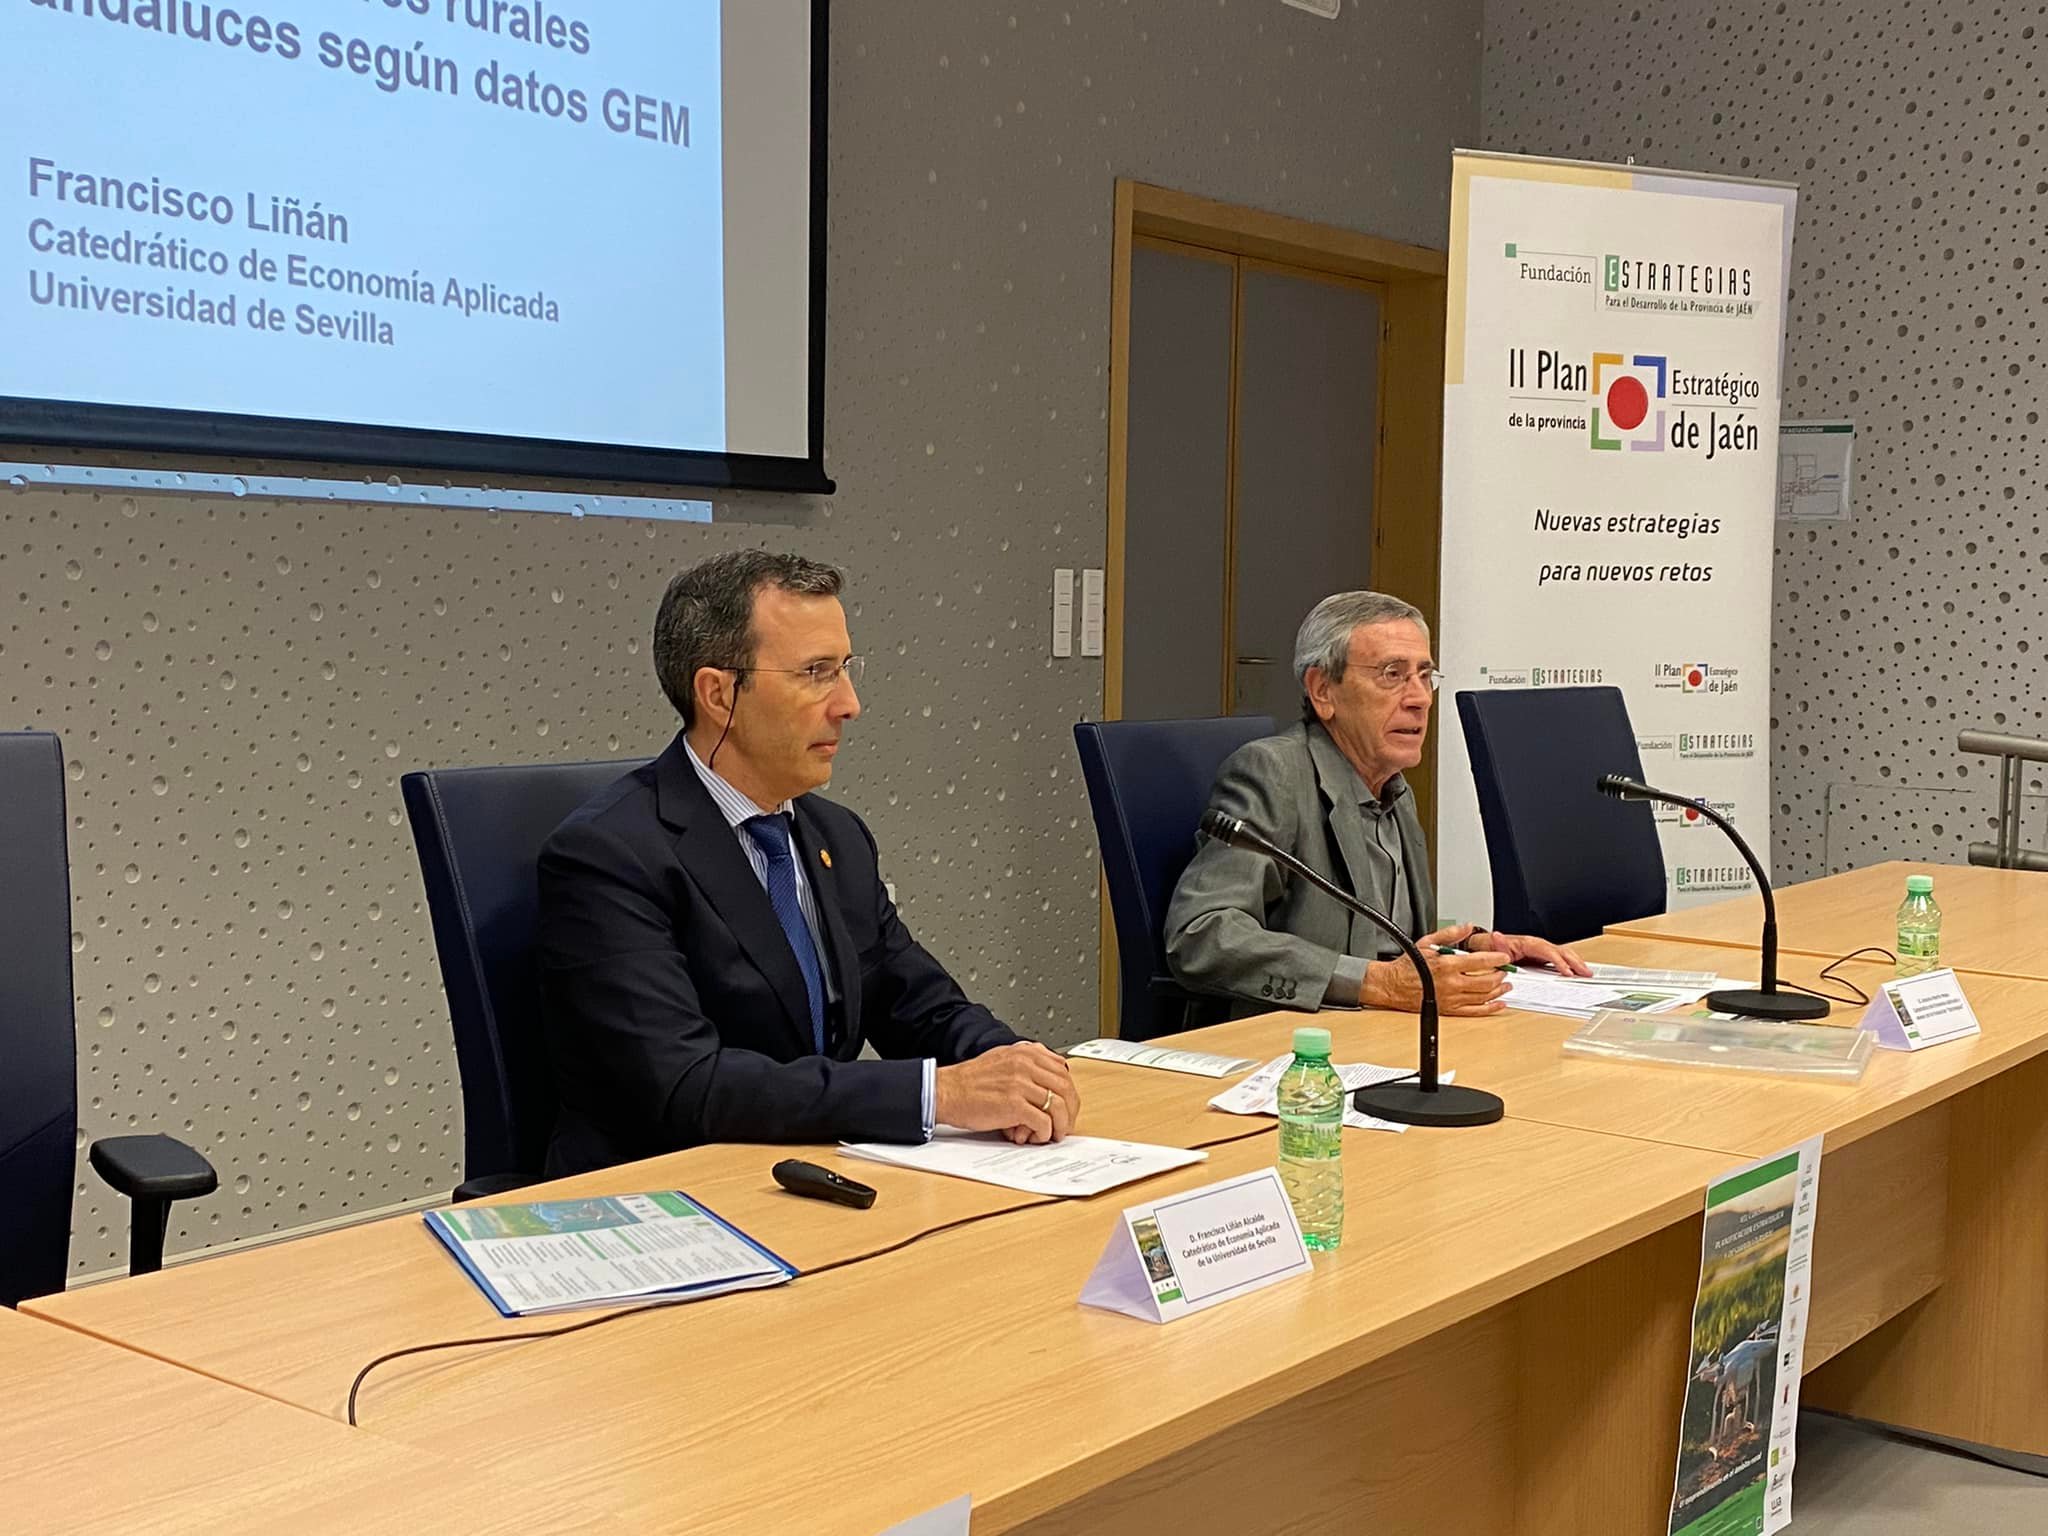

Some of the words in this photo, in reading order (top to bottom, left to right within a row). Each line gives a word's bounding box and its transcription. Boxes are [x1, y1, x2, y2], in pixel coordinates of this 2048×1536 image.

[318, 41, 458, 95] según
[475, 60, 588, 123] datos
[602, 88, 692, 148] GEM
[28, 157, 233, 224] Francisco
[247, 192, 349, 244] Liñán
[28, 218, 229, 276] Catedrático
[239, 249, 278, 283] de
[287, 254, 436, 306] Economía
[443, 277, 560, 323] Aplicada
[1520, 263, 1592, 284] Fundación
[1606, 255, 1751, 296] ESTRATEGIAS
[29, 269, 236, 327] Universidad
[247, 299, 286, 332] de
[295, 304, 394, 346] Sevilla
[1605, 295, 1621, 307] Para
[1623, 298, 1629, 308] el
[1631, 298, 1667, 310] Desarrollo
[1669, 301, 1678, 310] de
[1680, 301, 1688, 311] la
[1690, 301, 1724, 313] Provincia
[1725, 304, 1734, 313] de
[1508, 349, 1525, 389] II
[1537, 350, 1588, 392] Plan
[1671, 370, 1760, 404] Estratégico
[1508, 413, 1523, 428] de
[1525, 413, 1535, 428] la
[1537, 414, 1587, 433] provincia
[1671, 411, 1701, 450] de
[1706, 412, 1758, 459] Jaén
[1534, 509, 1602, 533] Nuevas
[1607, 513, 1721, 539] estrategias
[1538, 563, 1582, 586] para
[1587, 564, 1653, 583] nuevos
[1659, 563, 1713, 583] retos
[1532, 668, 1603, 686] ESTRATEGIAS
[1663, 664, 1681, 677] Plan
[1708, 680, 1718, 692] de
[1720, 680, 1738, 695] Jaén
[1680, 733, 1753, 751] ESTRATEGIAS
[1676, 867, 1750, 885] ESTRATEGIAS
[1182, 1241, 1217, 1259] Catedrático
[1217, 1239, 1226, 1247] de
[1226, 1230, 1254, 1245] Economía
[1255, 1221, 1280, 1236] Aplicada
[1189, 1234, 1197, 1243] D.
[1197, 1225, 1226, 1240] Francisco
[1197, 1258, 1206, 1267] de
[1206, 1256, 1212, 1265] la
[1212, 1244, 1248, 1263] Universidad
[1248, 1241, 1256, 1250] de
[1256, 1236, 1276, 1248] Sevilla
